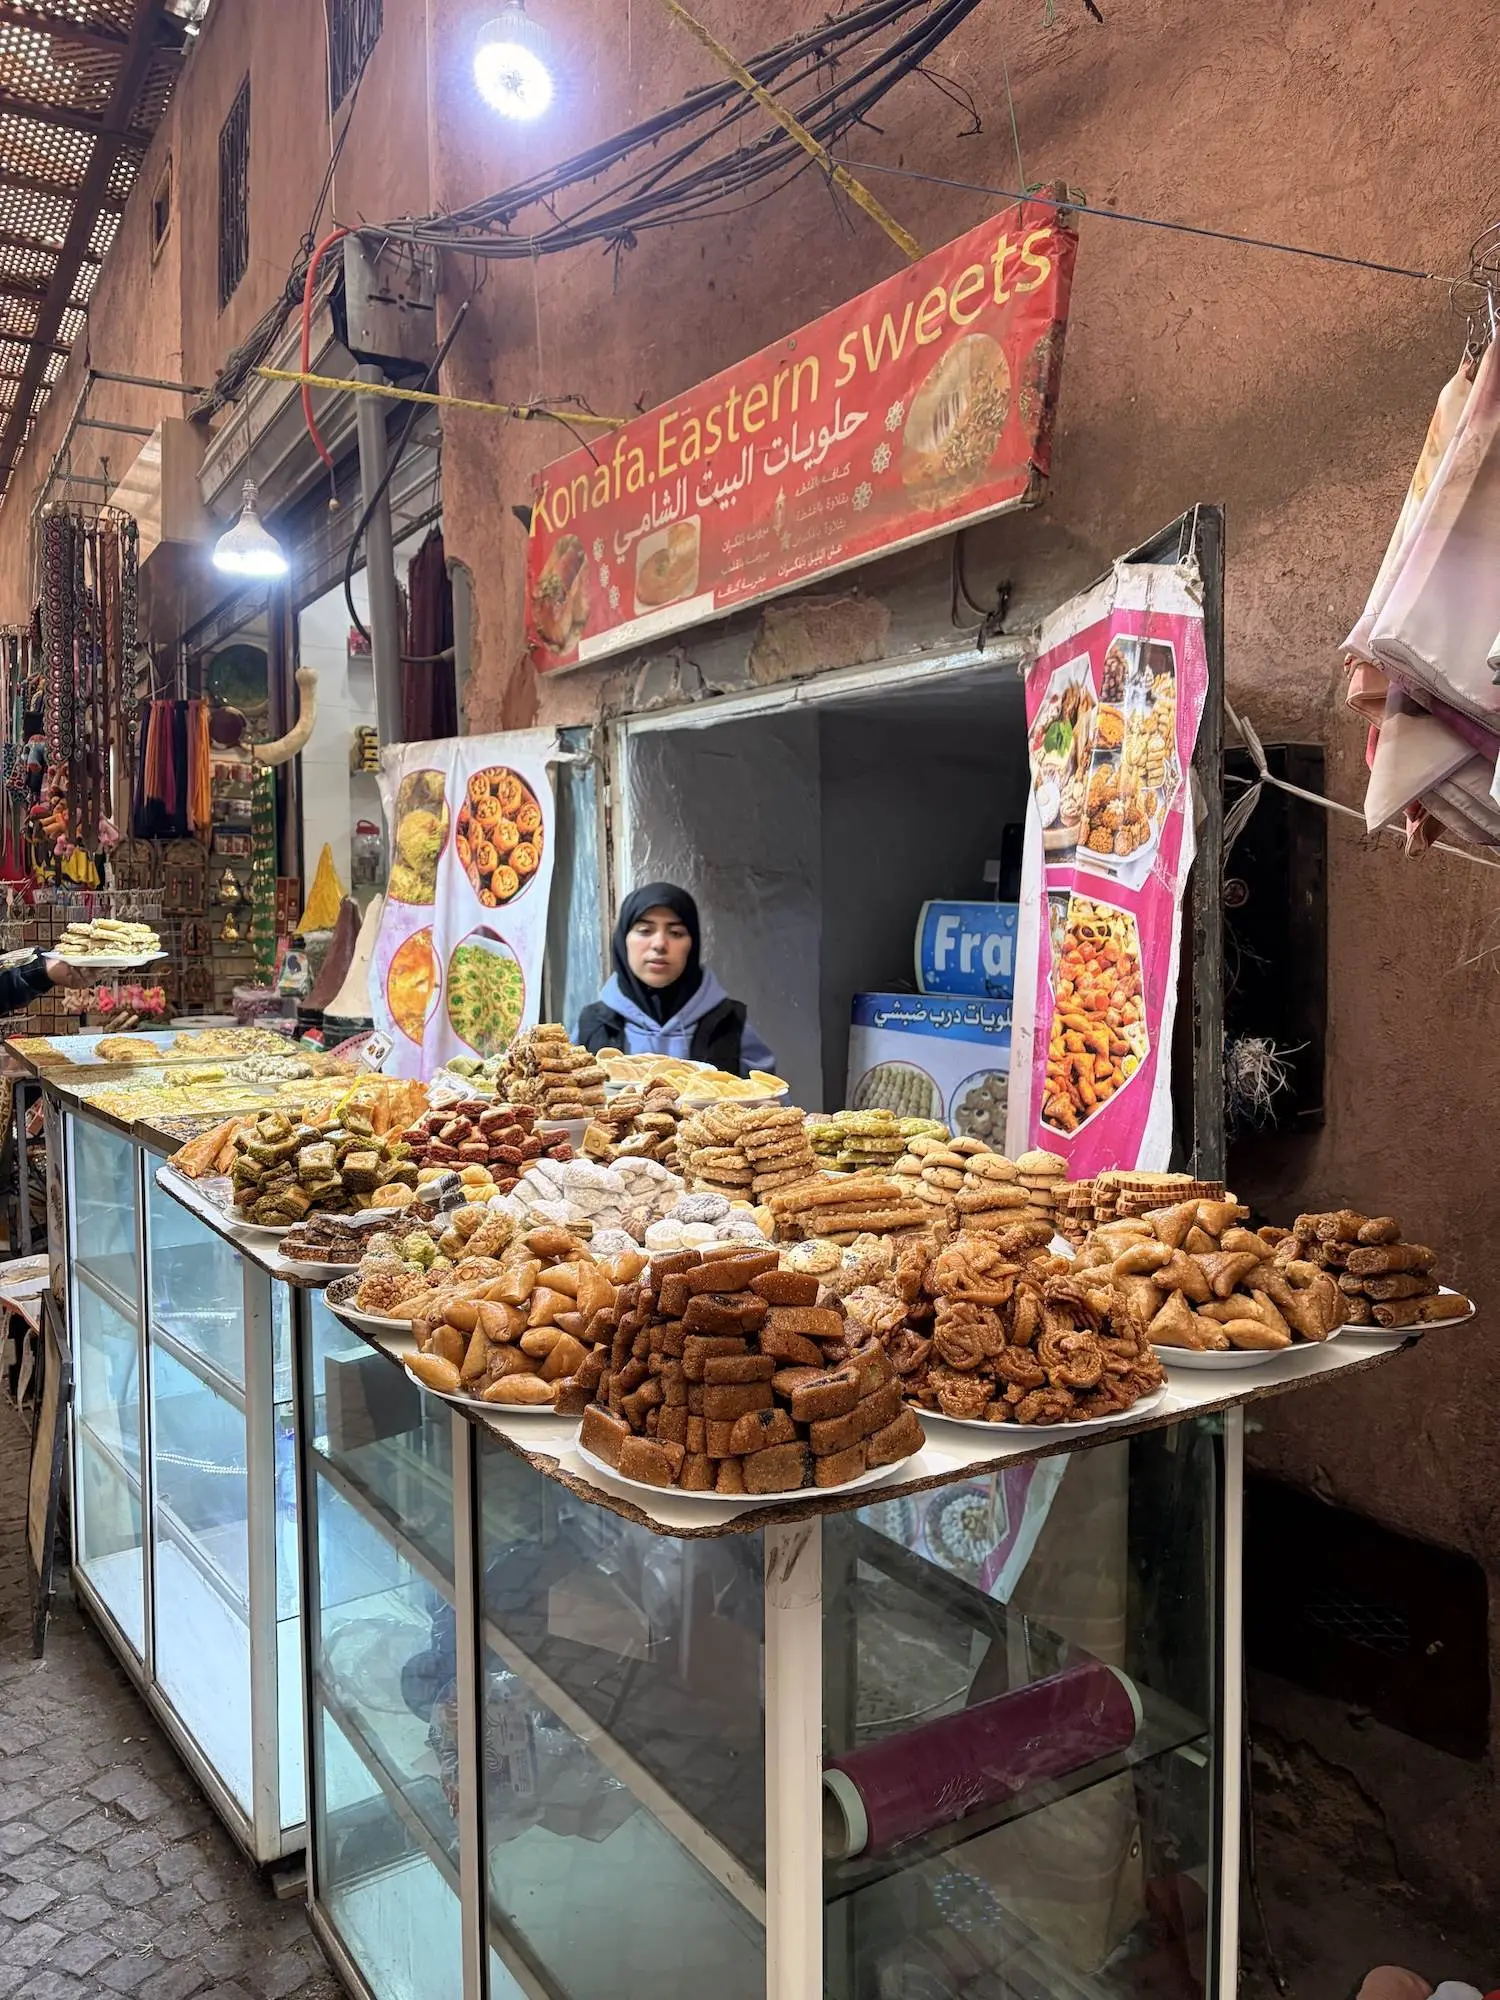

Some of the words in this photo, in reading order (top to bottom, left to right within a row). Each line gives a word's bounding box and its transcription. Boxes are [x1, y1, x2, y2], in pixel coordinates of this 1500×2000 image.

[529, 354, 820, 538] Konafa.Eastern
[834, 227, 1053, 388] sweets
[763, 396, 869, 476] حلويات
[695, 443, 754, 511] البيت
[613, 476, 688, 565] الشامي
[929, 1008, 961, 1028] درب
[964, 1004, 1013, 1032] لويات
